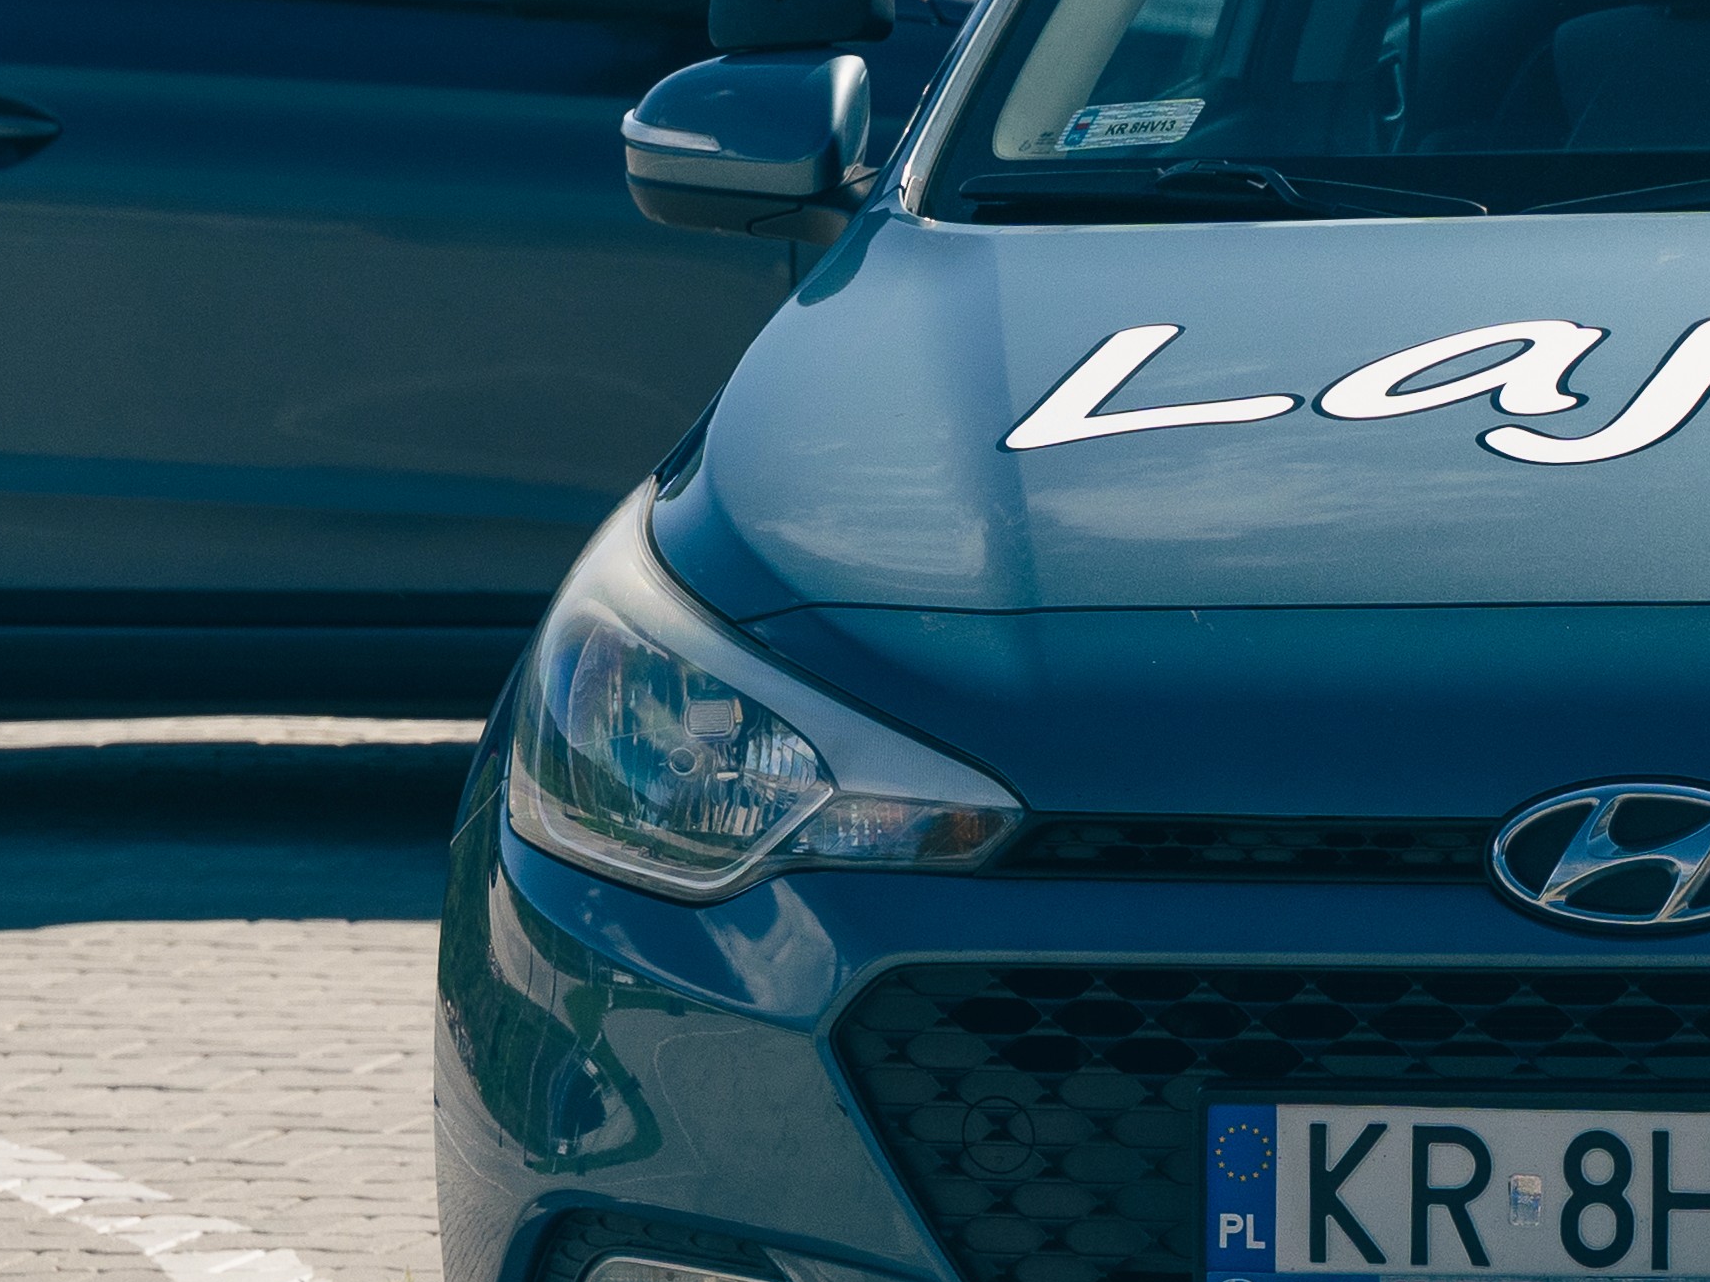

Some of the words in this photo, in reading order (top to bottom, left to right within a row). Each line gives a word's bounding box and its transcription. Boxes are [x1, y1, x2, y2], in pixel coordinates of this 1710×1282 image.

[1104, 124, 1128, 137] KR
[1129, 120, 1177, 134] 8HV13
[1308, 1122, 1492, 1267] KR
[1218, 1212, 1267, 1250] PL
